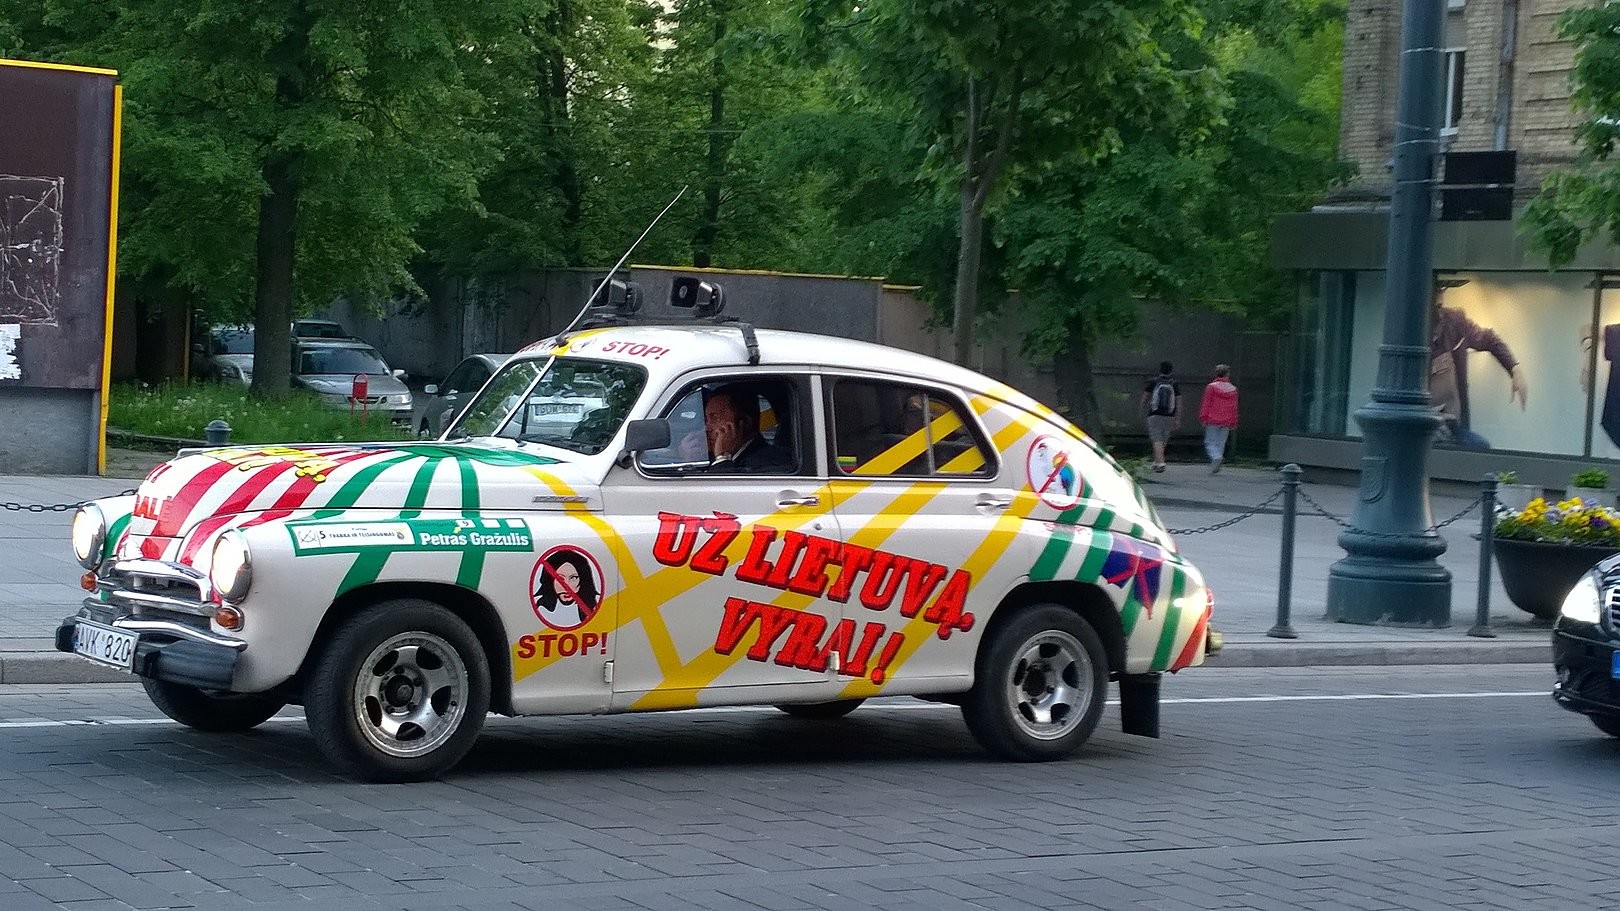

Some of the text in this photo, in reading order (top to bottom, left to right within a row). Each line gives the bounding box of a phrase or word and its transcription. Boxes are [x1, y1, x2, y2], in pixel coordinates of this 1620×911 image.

[602, 341, 671, 360] STOP!
[420, 532, 529, 546] Petras Gražulis
[652, 511, 741, 576] UŽ
[79, 626, 131, 662] AVK 820
[517, 632, 608, 659] STOP!
[714, 596, 905, 685] VYRAI!
